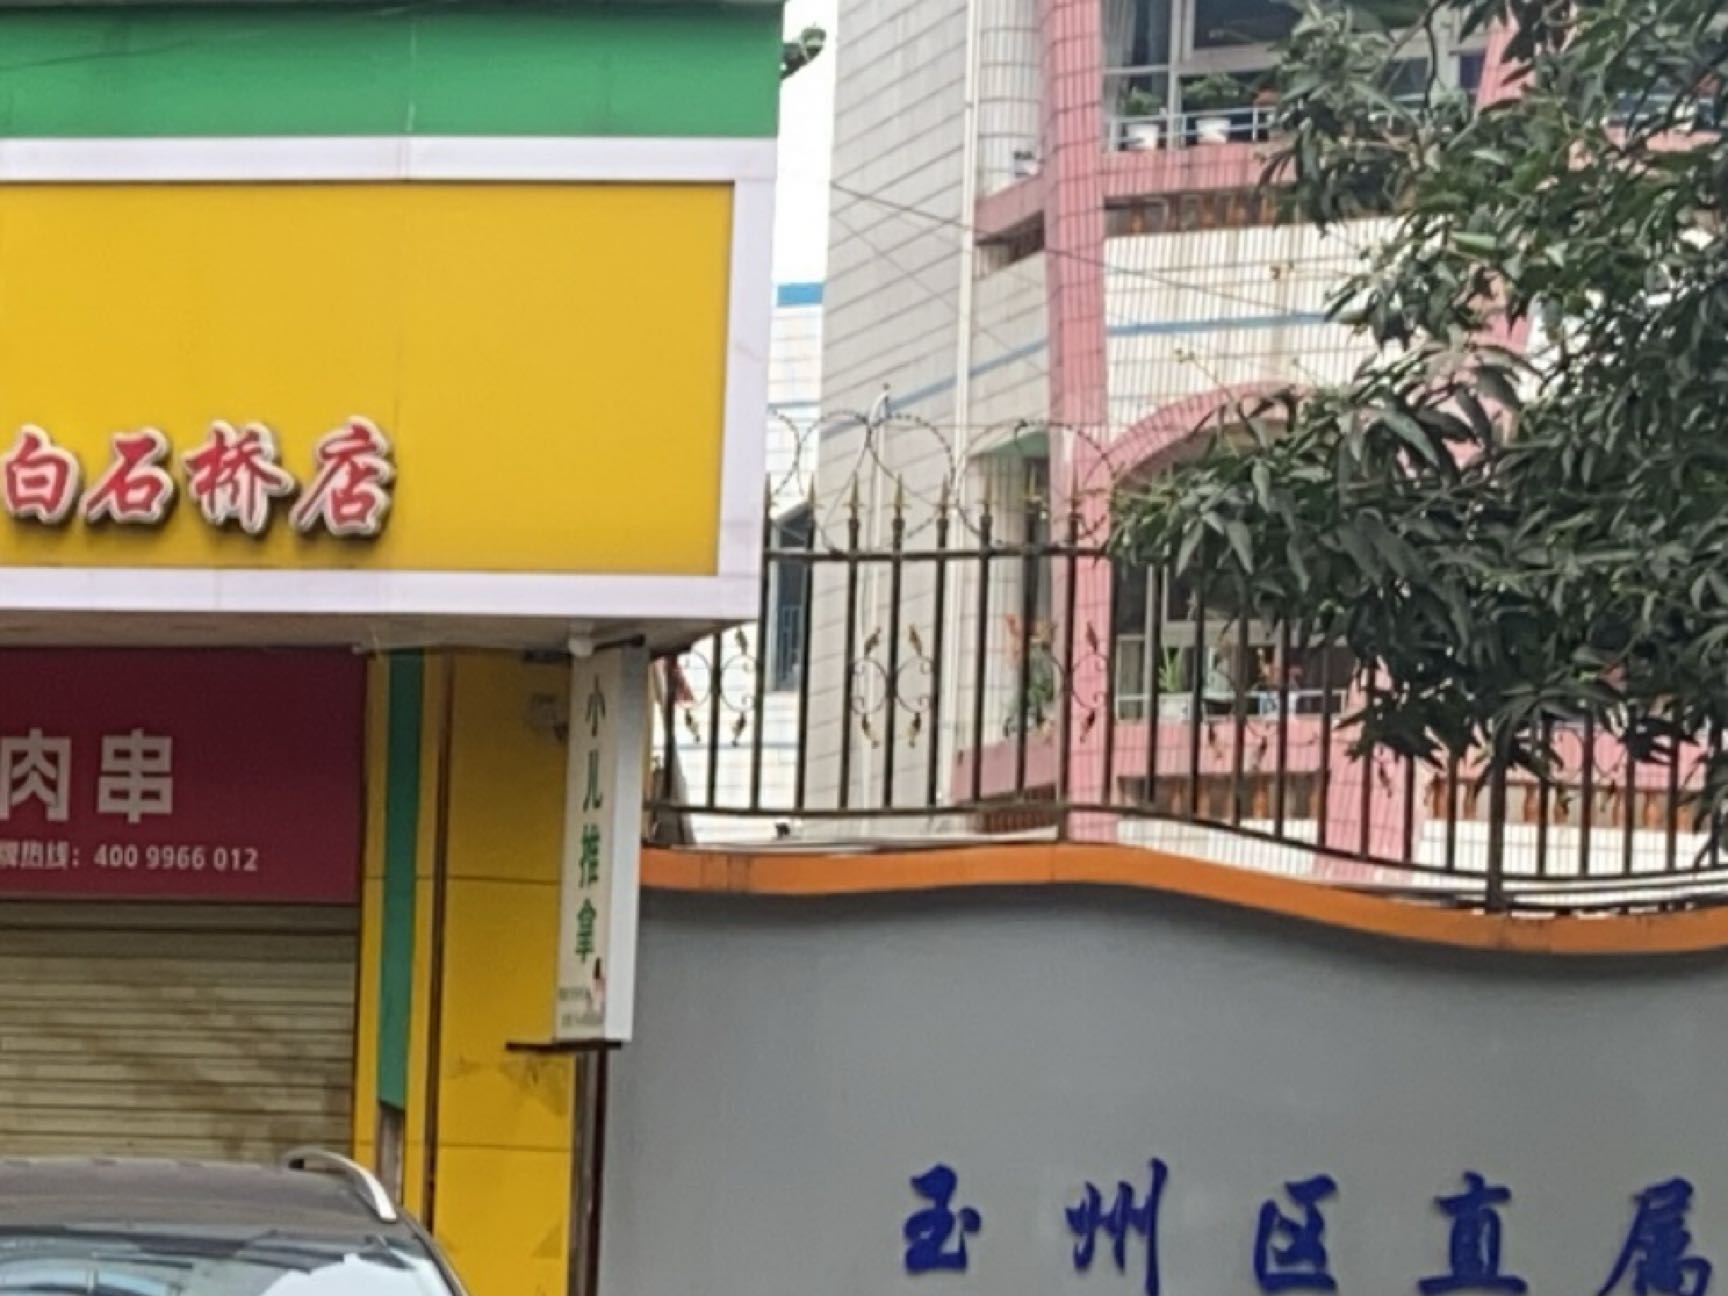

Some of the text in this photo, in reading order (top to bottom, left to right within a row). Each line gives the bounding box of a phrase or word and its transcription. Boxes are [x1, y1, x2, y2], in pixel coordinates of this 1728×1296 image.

[93, 843, 139, 868] 400
[145, 844, 206, 870] 9966
[213, 846, 259, 871] 012
[575, 674, 607, 963] 小儿推拿
